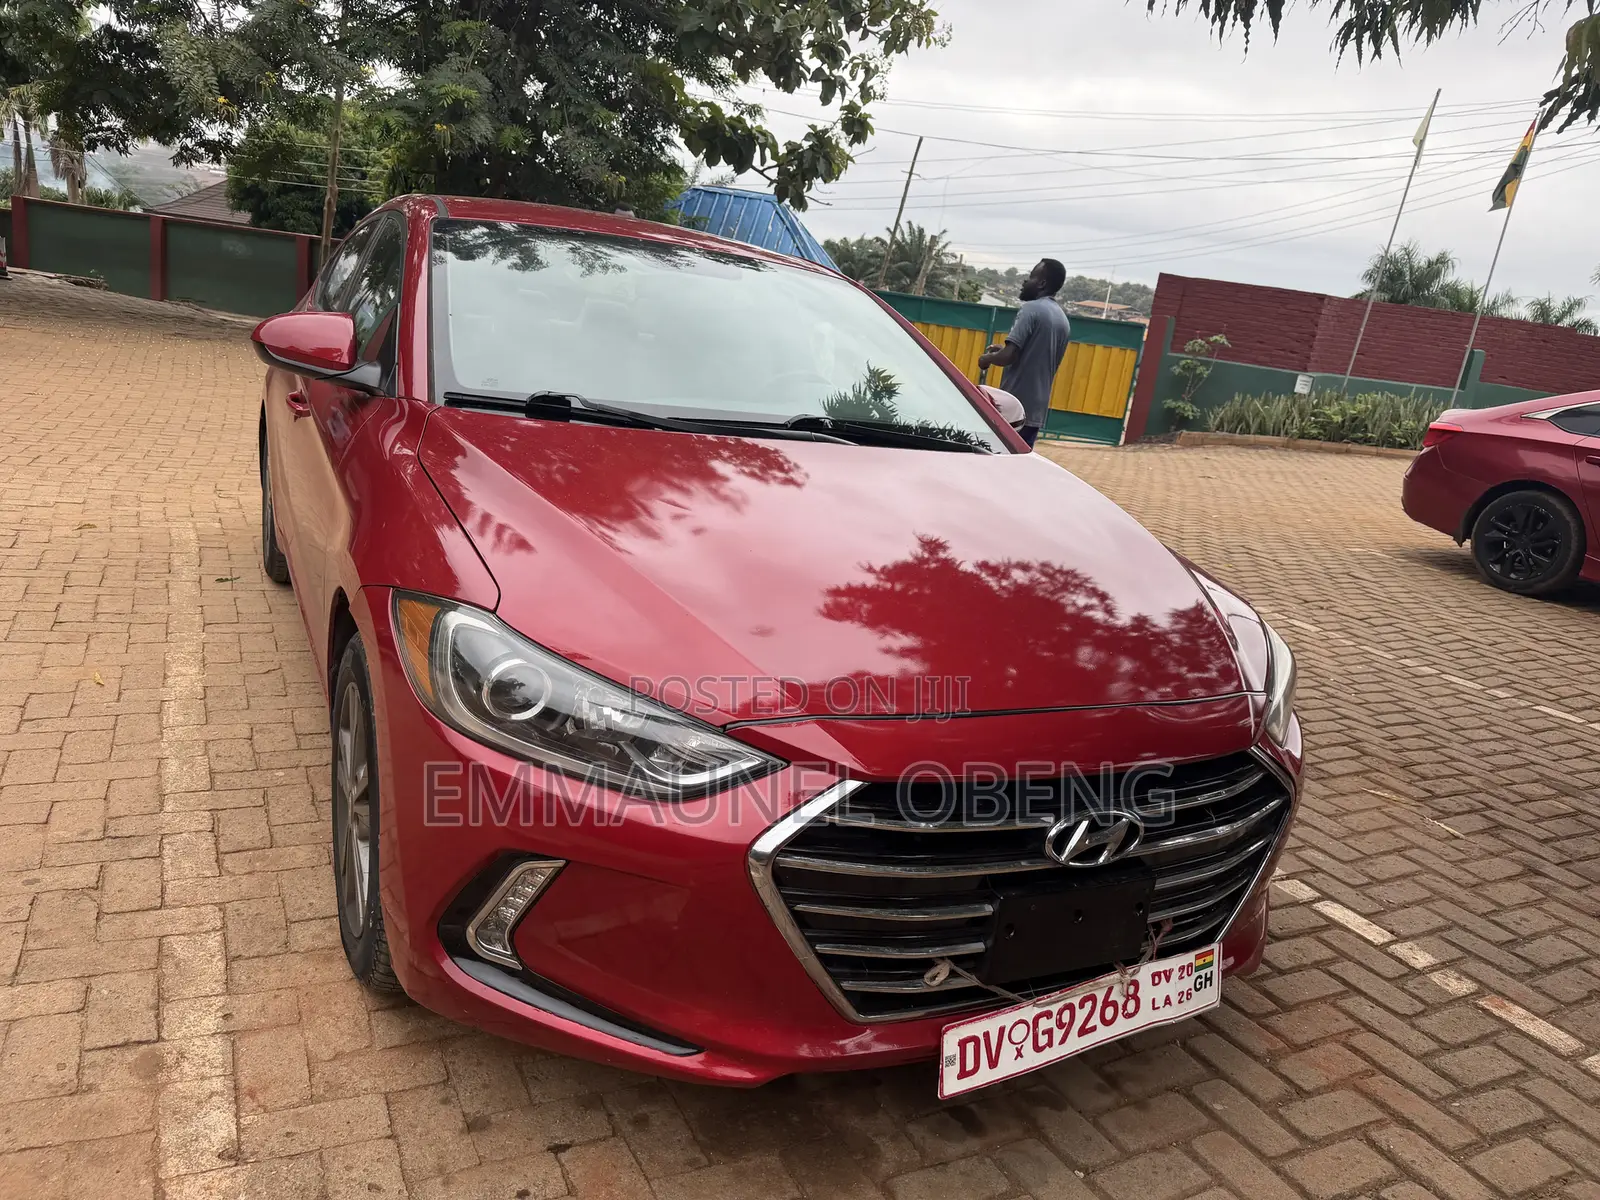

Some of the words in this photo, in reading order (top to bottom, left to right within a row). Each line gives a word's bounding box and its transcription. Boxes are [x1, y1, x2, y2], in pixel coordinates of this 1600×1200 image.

[1151, 968, 1174, 987] DV
[1178, 962, 1194, 980] 20
[1194, 970, 1214, 992] GH
[1151, 994, 1173, 1011] LA
[1177, 988, 1193, 1005] 26
